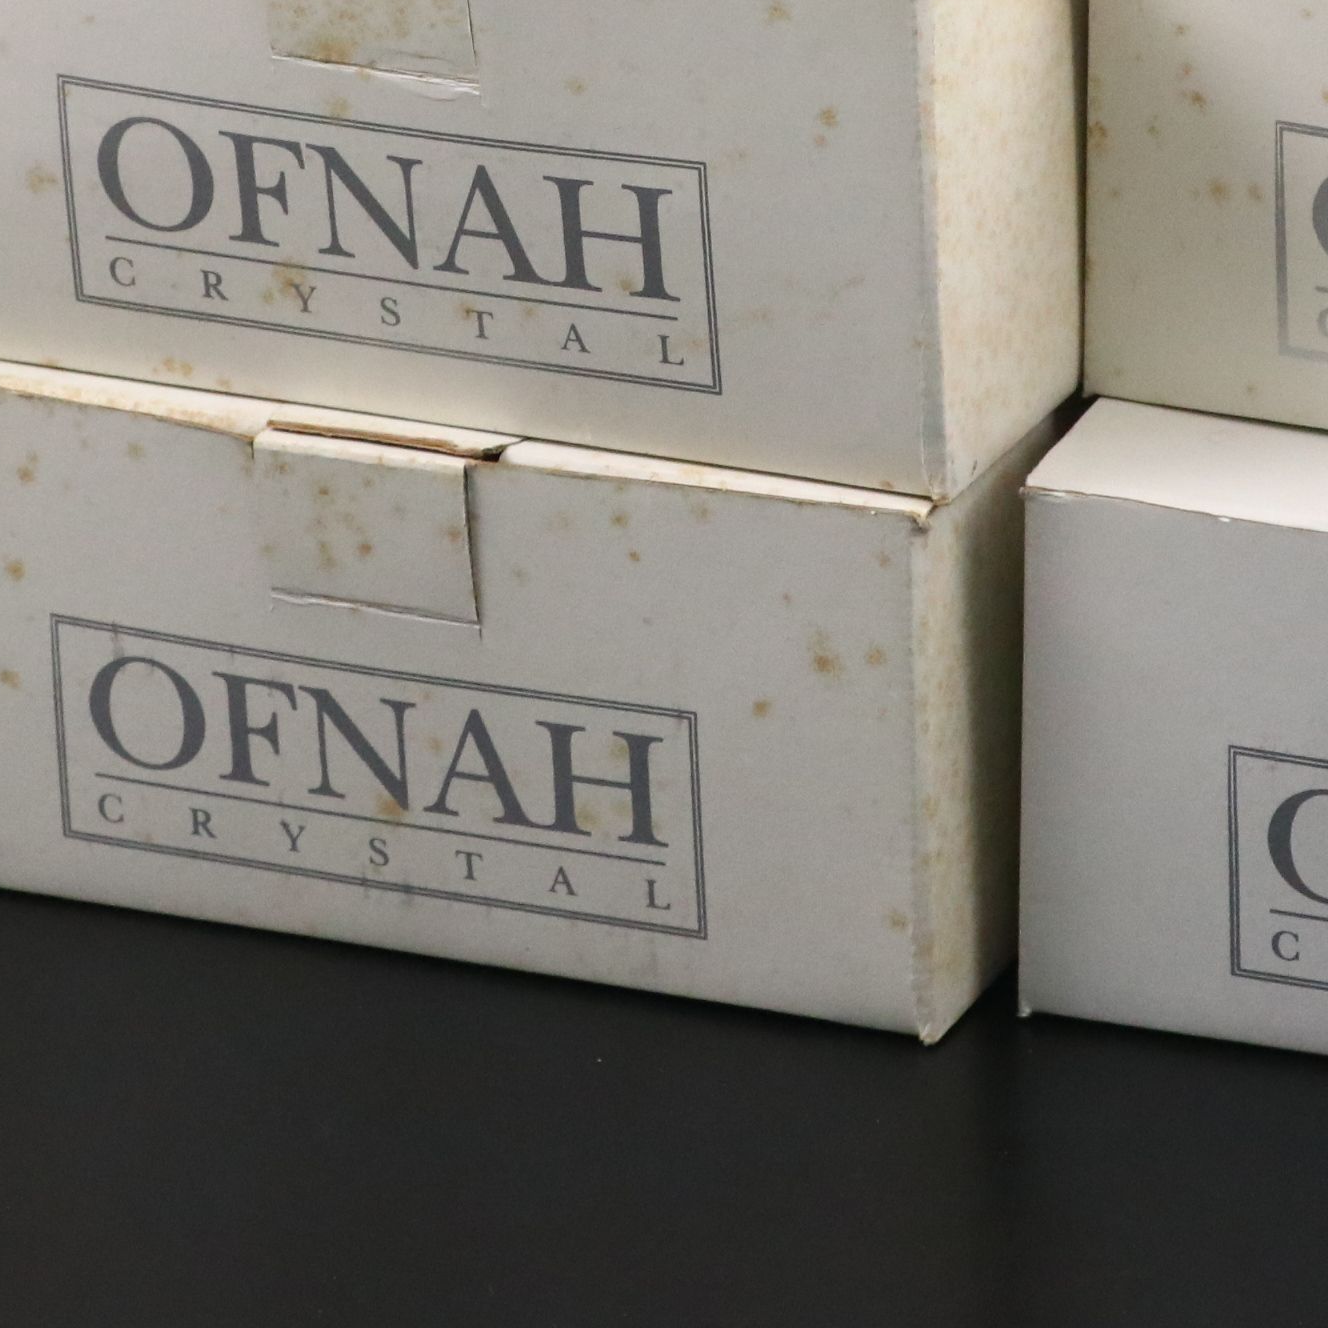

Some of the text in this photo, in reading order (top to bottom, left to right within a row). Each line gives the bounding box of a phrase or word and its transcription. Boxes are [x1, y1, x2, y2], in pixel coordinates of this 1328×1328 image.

[97, 115, 681, 302] OFNAH
[108, 256, 684, 367] CRYSTAL
[88, 655, 669, 848] OFNAH
[97, 793, 672, 911] CRYSTAL
